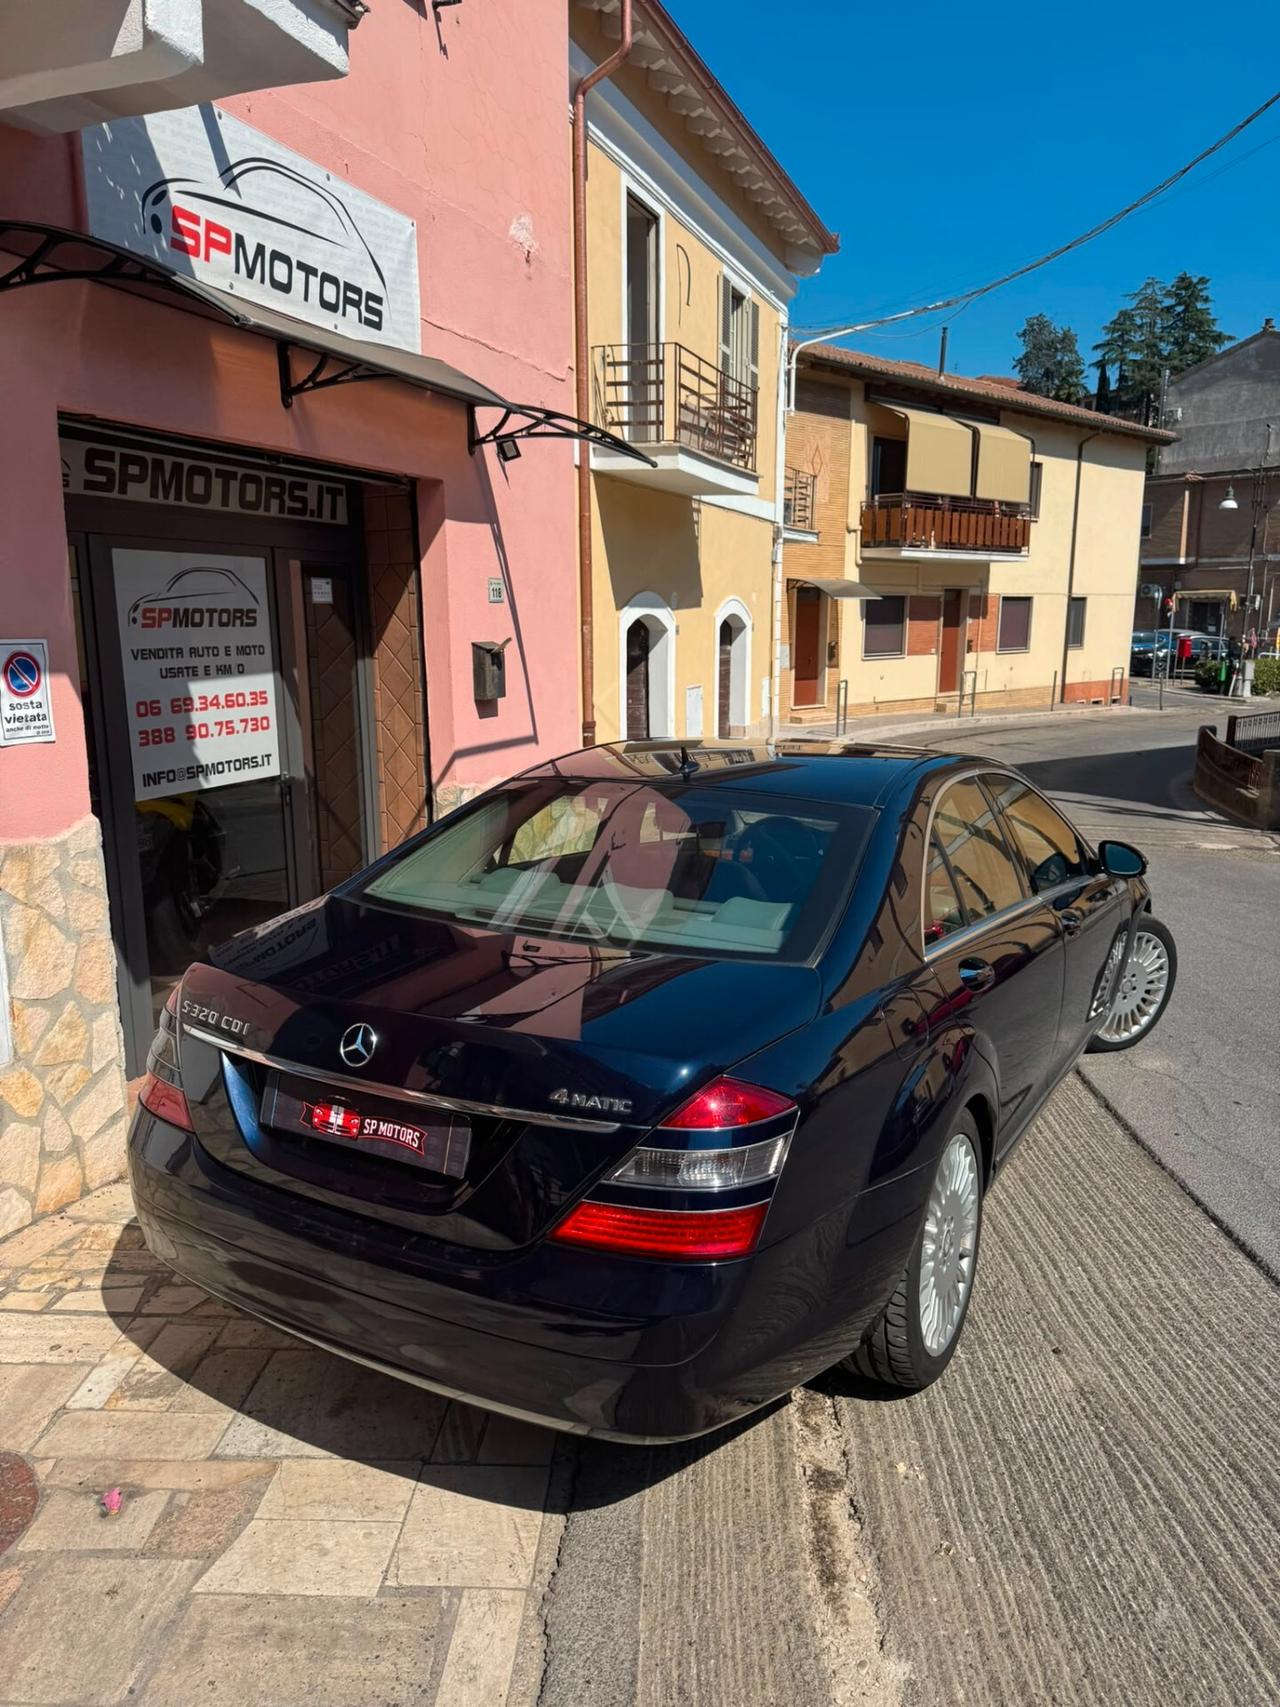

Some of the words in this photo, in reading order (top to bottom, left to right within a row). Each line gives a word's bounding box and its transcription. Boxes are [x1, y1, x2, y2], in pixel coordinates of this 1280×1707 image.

[170, 204, 384, 332] SPMOTORS
[83, 447, 344, 521] SPMOTORS.IT
[141, 607, 257, 629] SPMOTORS
[130, 647, 184, 661] VENDITA
[189, 646, 220, 659] AUTO
[224, 645, 231, 656] E
[236, 645, 265, 656] MOTO
[160, 666, 199, 679] USATE
[204, 665, 211, 676] E
[216, 664, 232, 676] KM
[9, 700, 42, 711] sosta
[135, 700, 162, 718] 06
[170, 690, 268, 714] 69.34.60.35
[4, 712, 47, 724] vietata
[138, 726, 176, 747] 388
[185, 716, 270, 741] 90.75.730
[142, 754, 272, 788] INFO@SPMOTORS.IT
[221, 1015, 250, 1036] CDI
[363, 1118, 377, 1134] SP
[378, 1121, 420, 1148] MOTORS
